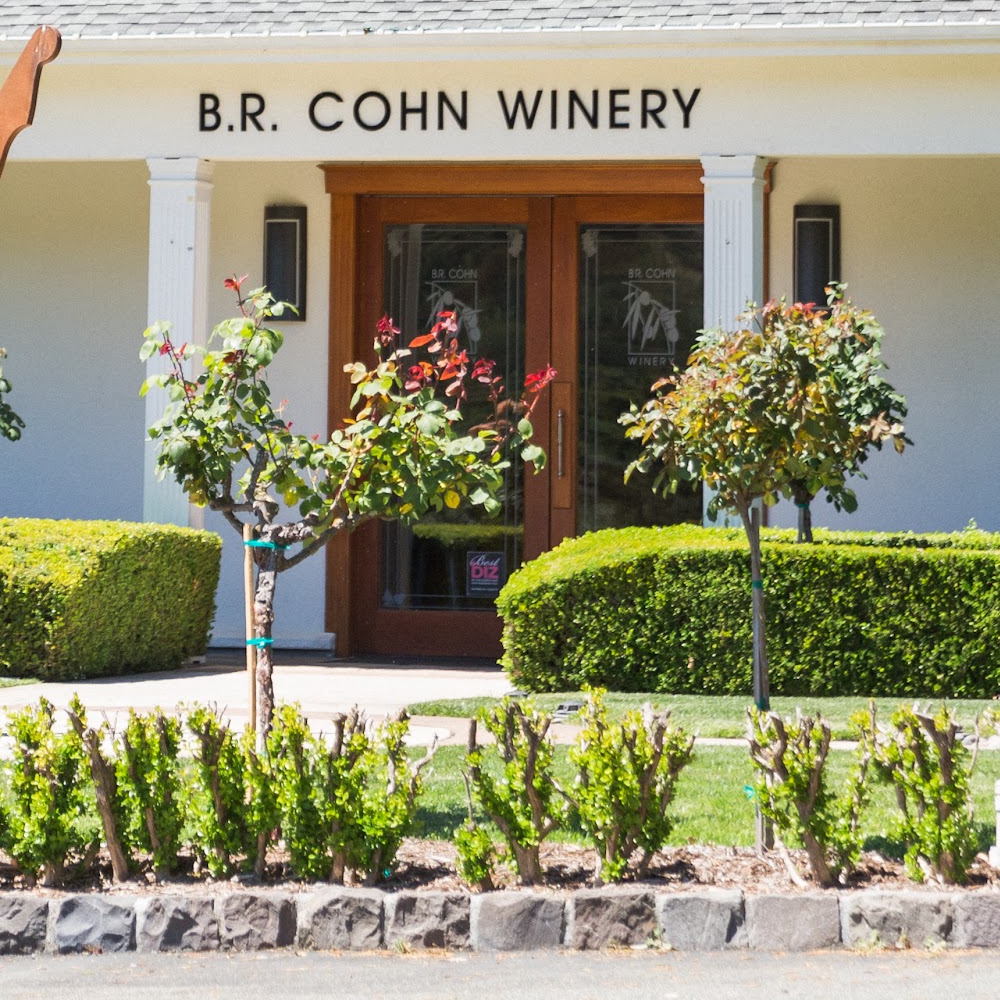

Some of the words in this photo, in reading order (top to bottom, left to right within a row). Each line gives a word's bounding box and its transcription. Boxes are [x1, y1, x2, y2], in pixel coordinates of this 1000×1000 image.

[198, 92, 278, 132] B.R.
[307, 90, 469, 132] COHN
[496, 87, 701, 130] WINERY
[448, 268, 477, 280] COHN
[645, 268, 675, 279] COHN
[627, 356, 675, 366] WINERY
